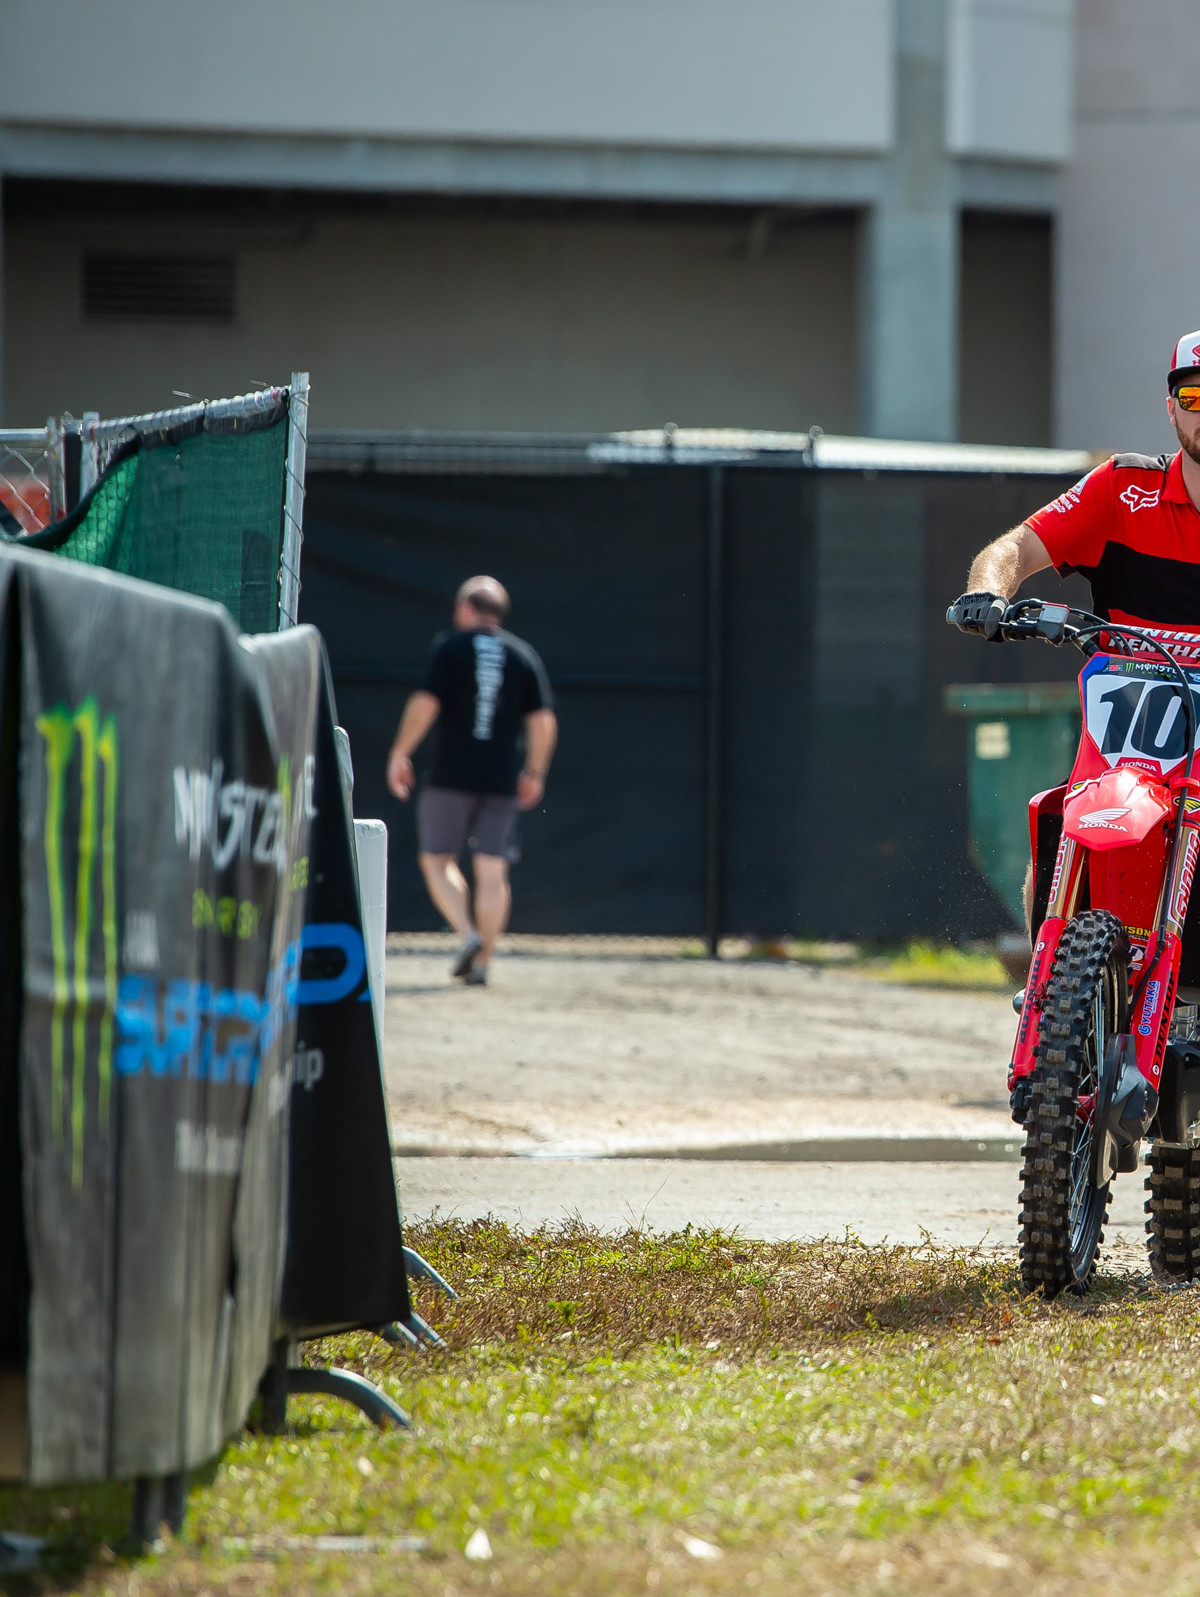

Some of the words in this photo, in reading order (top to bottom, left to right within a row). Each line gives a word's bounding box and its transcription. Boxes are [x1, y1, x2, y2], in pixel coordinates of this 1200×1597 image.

[1135, 662, 1186, 677] MONSTE
[1120, 761, 1157, 772] HONDA
[1077, 821, 1128, 833] HONDA
[1139, 980, 1159, 1024] YUTAKA
